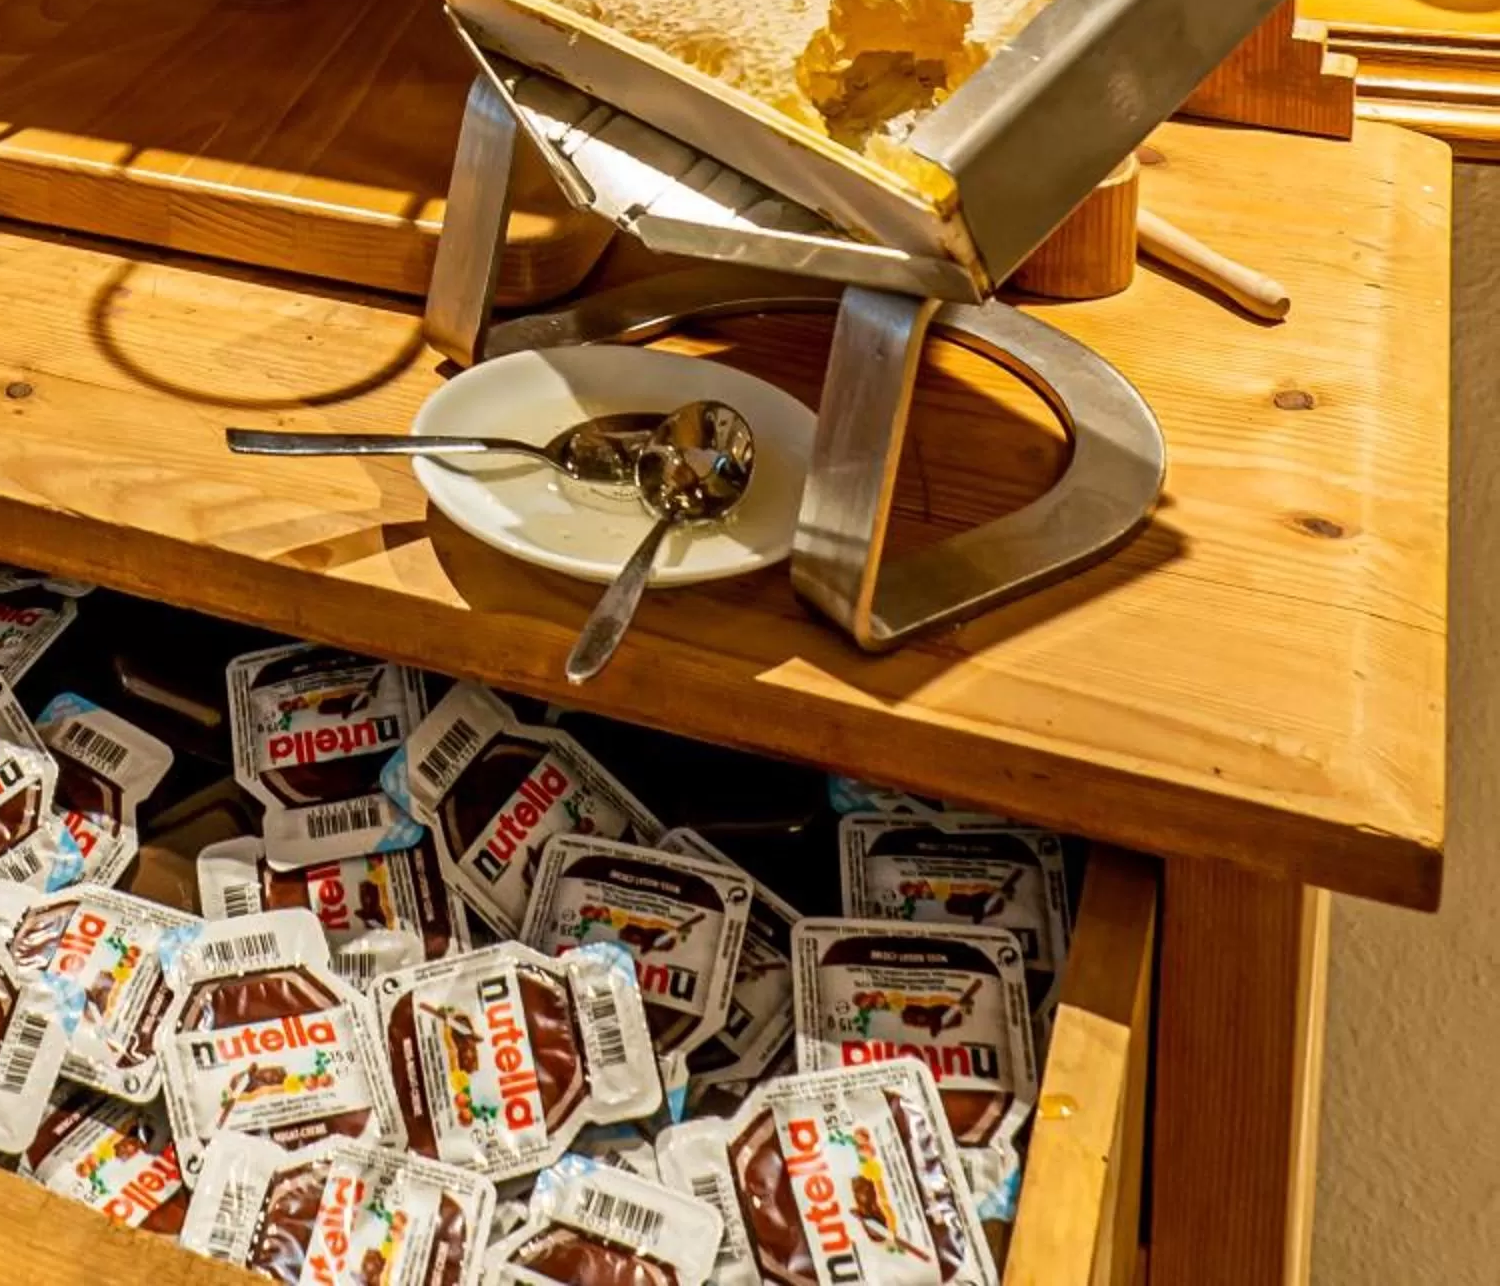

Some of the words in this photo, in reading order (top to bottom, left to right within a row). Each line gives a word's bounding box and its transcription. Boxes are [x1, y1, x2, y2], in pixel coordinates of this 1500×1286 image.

[268, 715, 401, 763] nutella
[472, 761, 569, 885] nutella
[192, 1016, 337, 1066] nutella
[477, 977, 538, 1131] nutella
[786, 1117, 859, 1283] nutella
